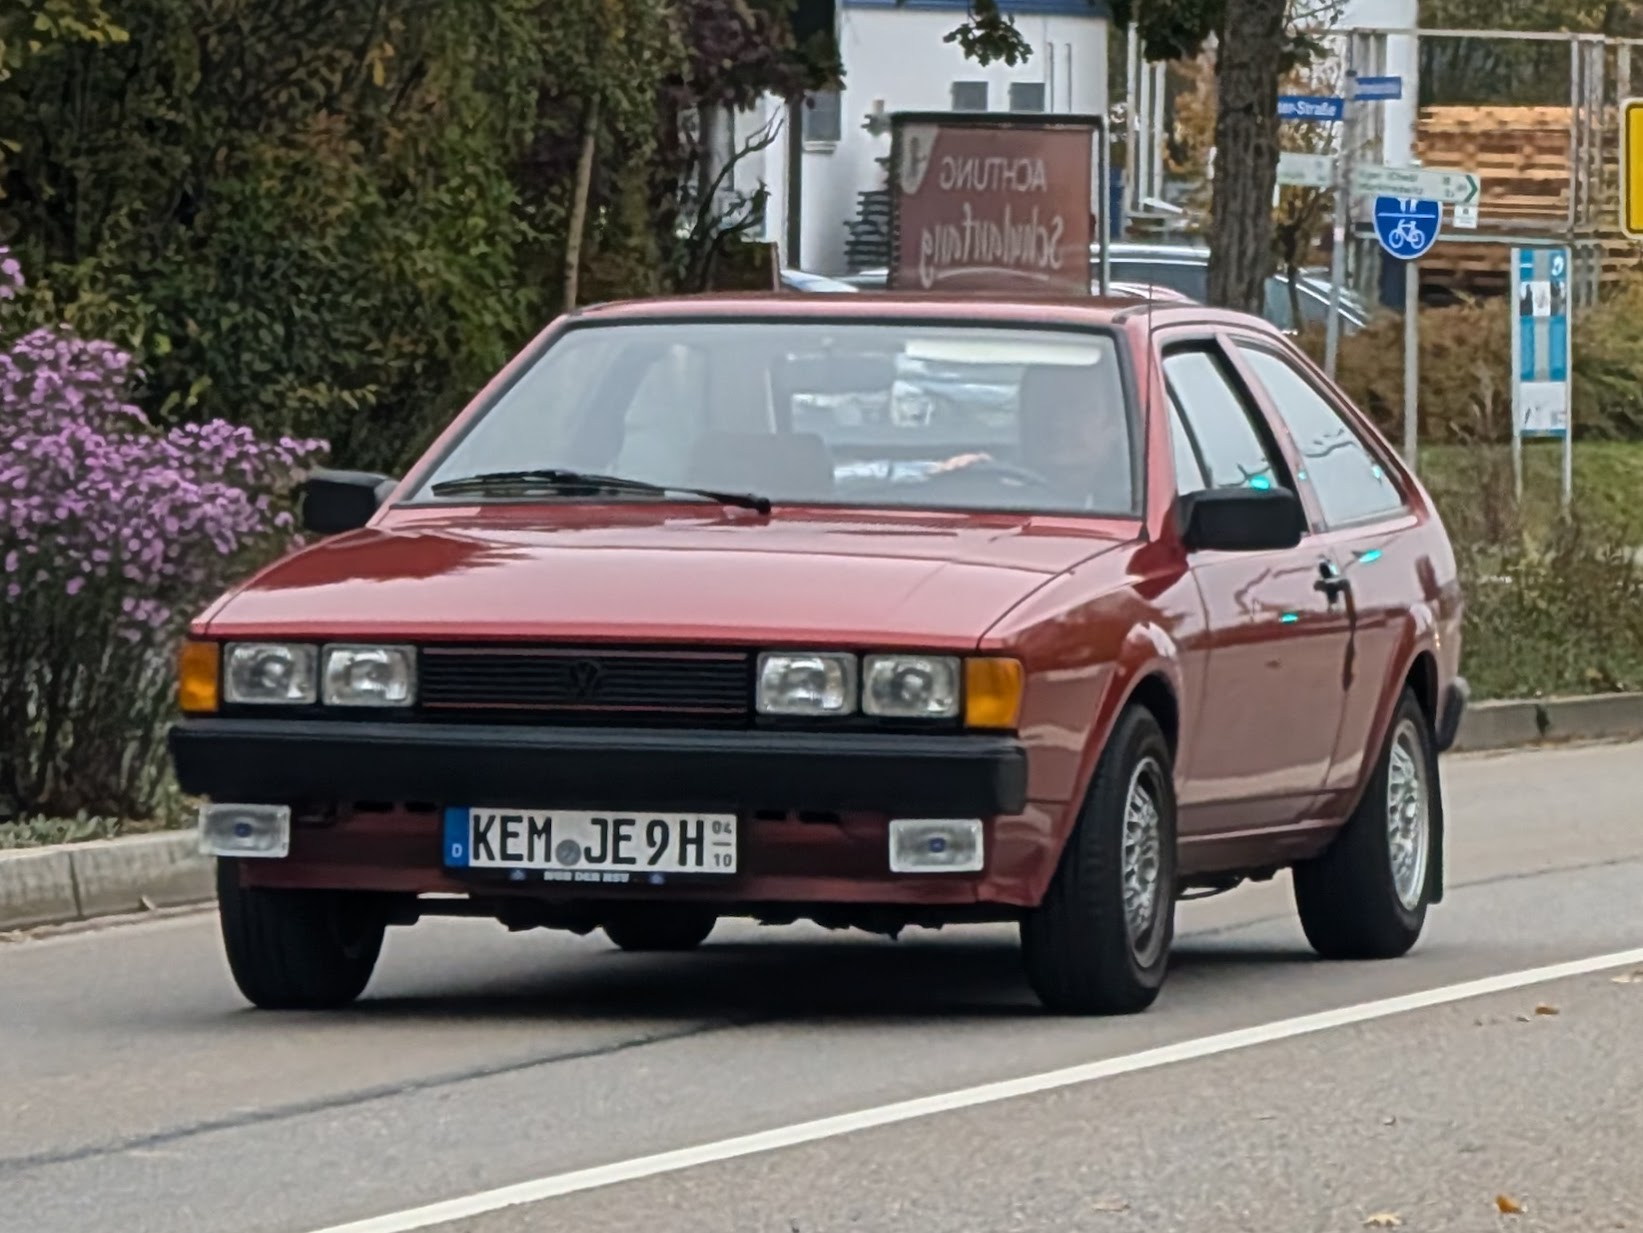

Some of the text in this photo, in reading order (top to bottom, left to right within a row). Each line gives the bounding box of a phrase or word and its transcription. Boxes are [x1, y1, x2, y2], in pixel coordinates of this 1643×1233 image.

[712, 820, 732, 835] 04
[472, 815, 552, 863] KEM
[451, 843, 462, 858] D
[713, 853, 733, 867] 10
